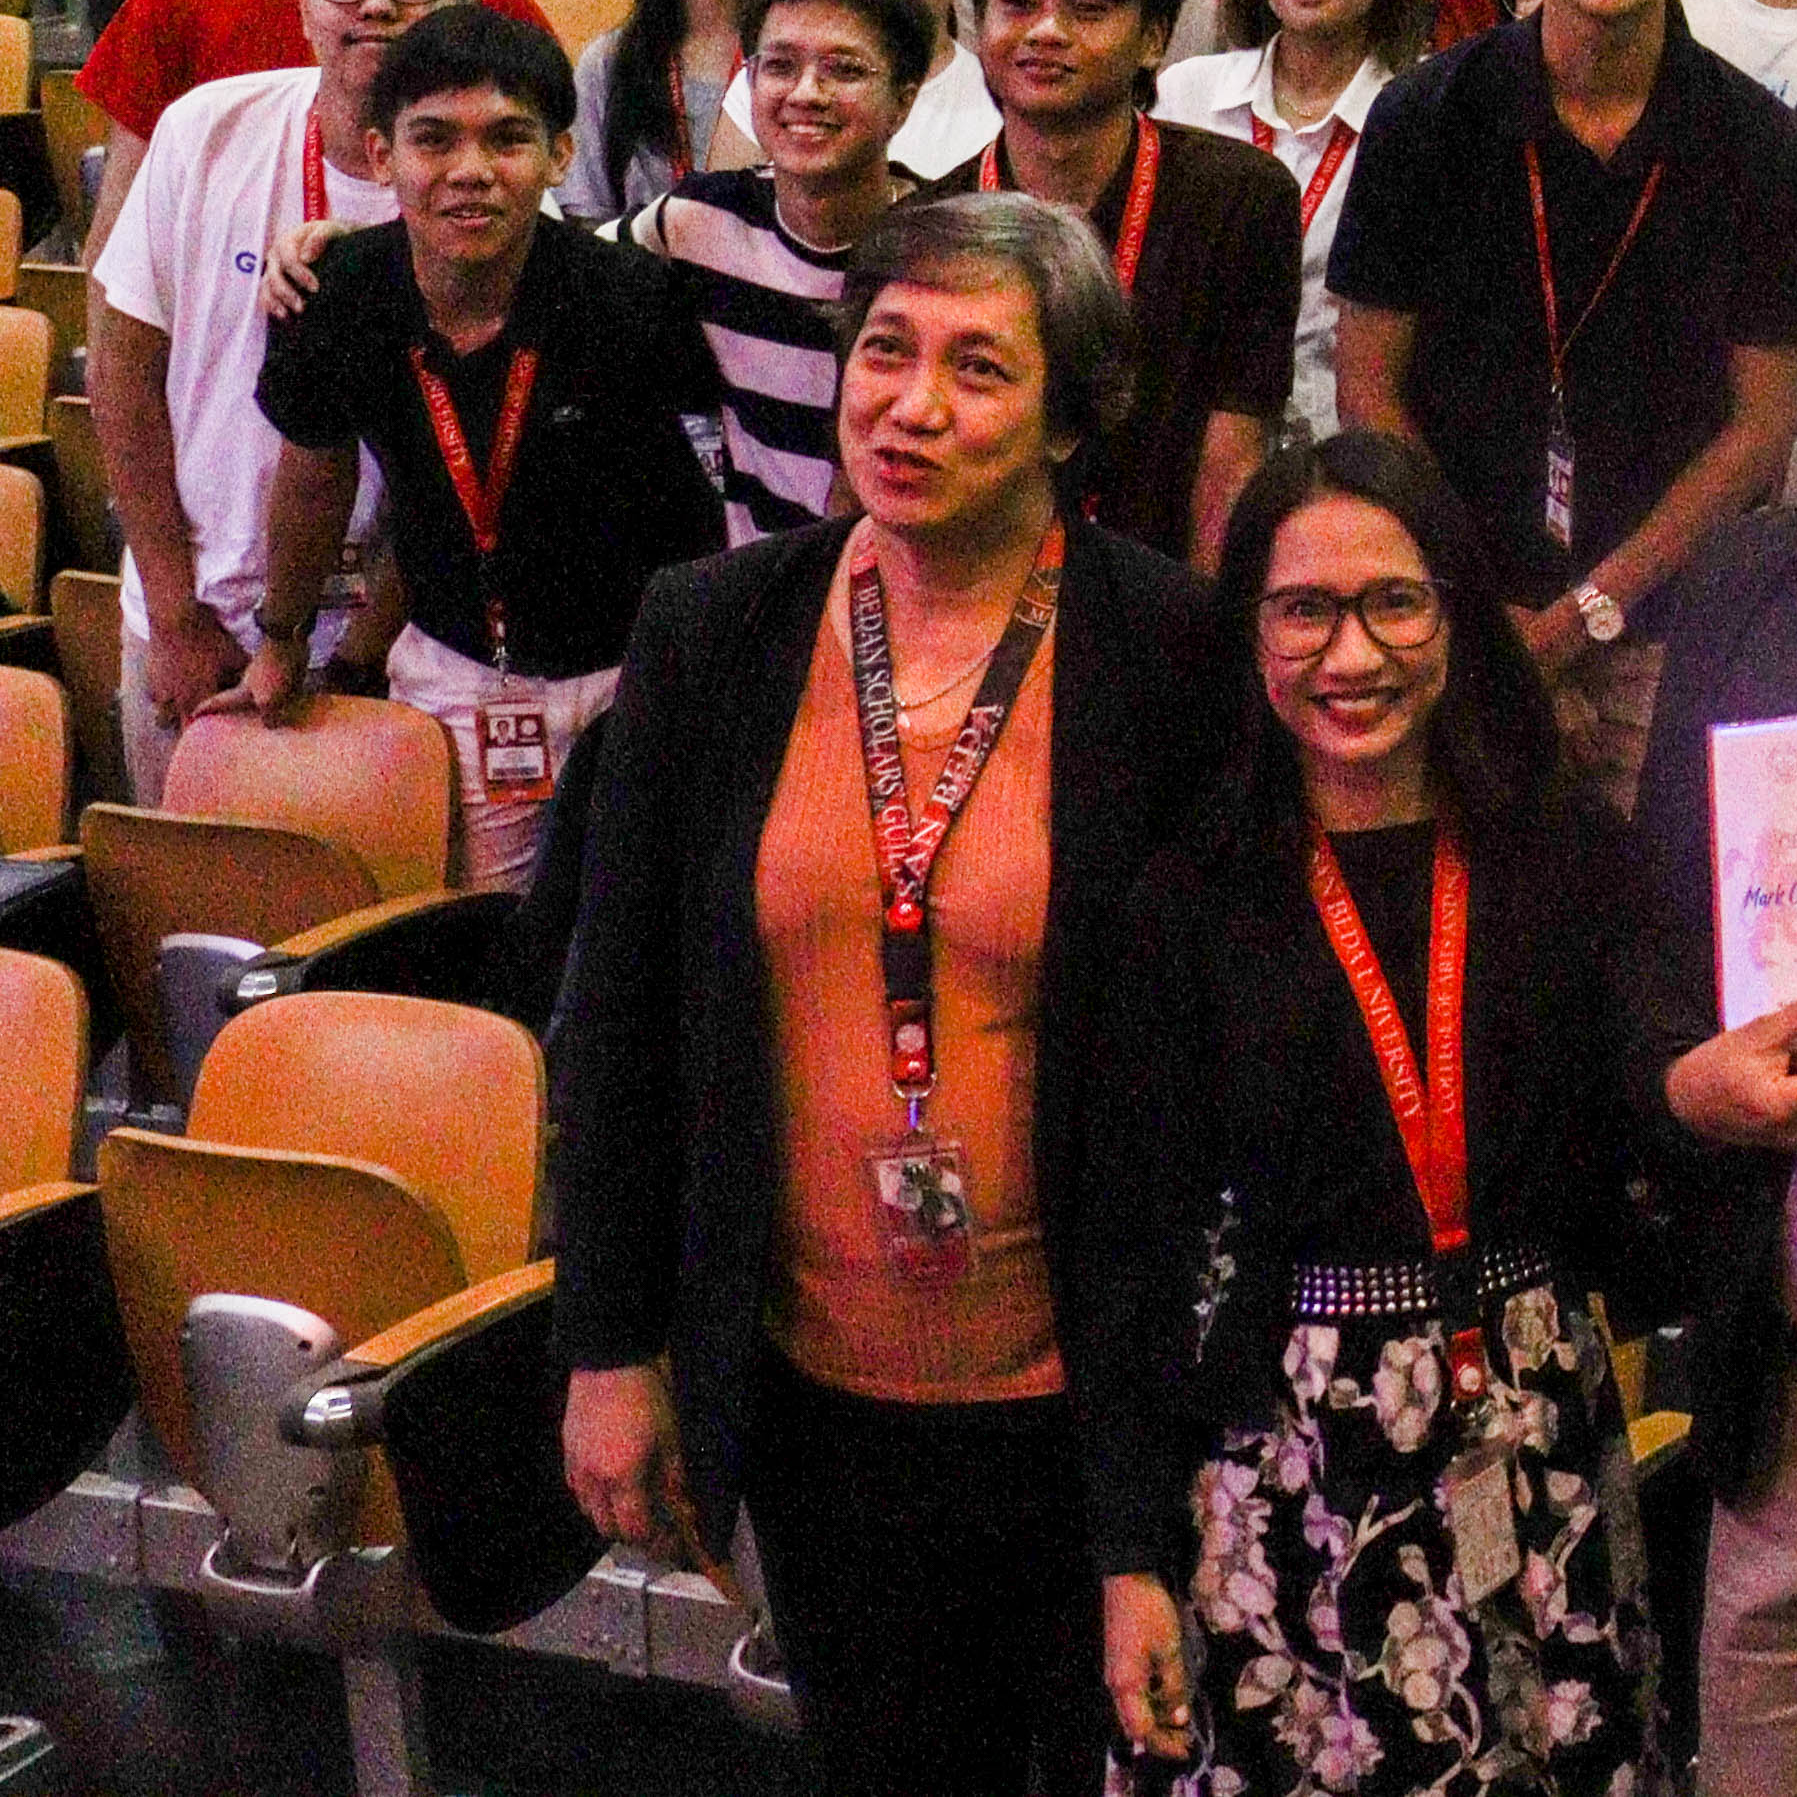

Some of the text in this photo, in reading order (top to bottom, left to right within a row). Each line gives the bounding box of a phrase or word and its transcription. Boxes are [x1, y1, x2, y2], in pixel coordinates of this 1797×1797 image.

[855, 585, 888, 665] BEDAN
[1744, 884, 1785, 908] Mark
[1357, 965, 1421, 1117] UNIVERSITY
